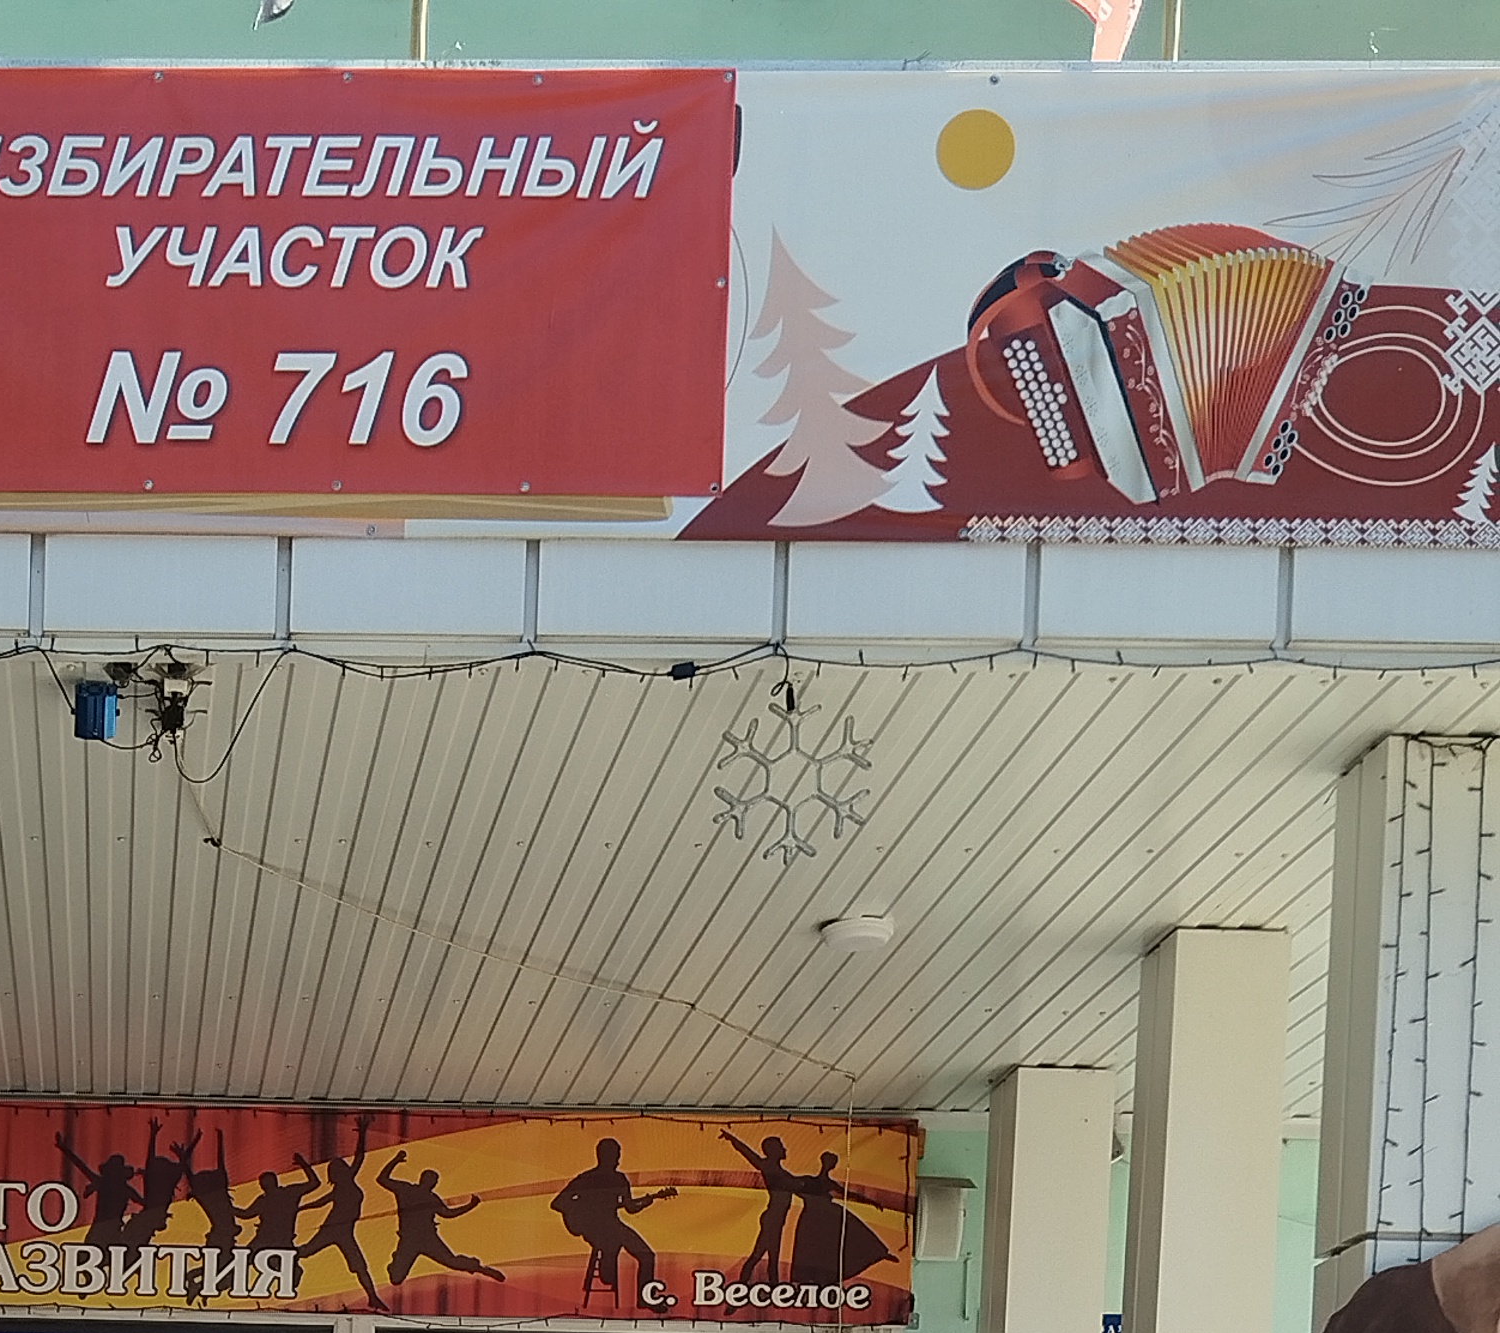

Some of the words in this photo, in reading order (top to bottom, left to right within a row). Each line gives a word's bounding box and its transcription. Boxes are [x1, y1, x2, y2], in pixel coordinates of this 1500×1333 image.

[105, 226, 484, 288] УЧАСТОК
[86, 351, 230, 445] №
[267, 351, 470, 447] 716
[641, 1281, 677, 1306] с.
[693, 1272, 870, 1309] Веселое
